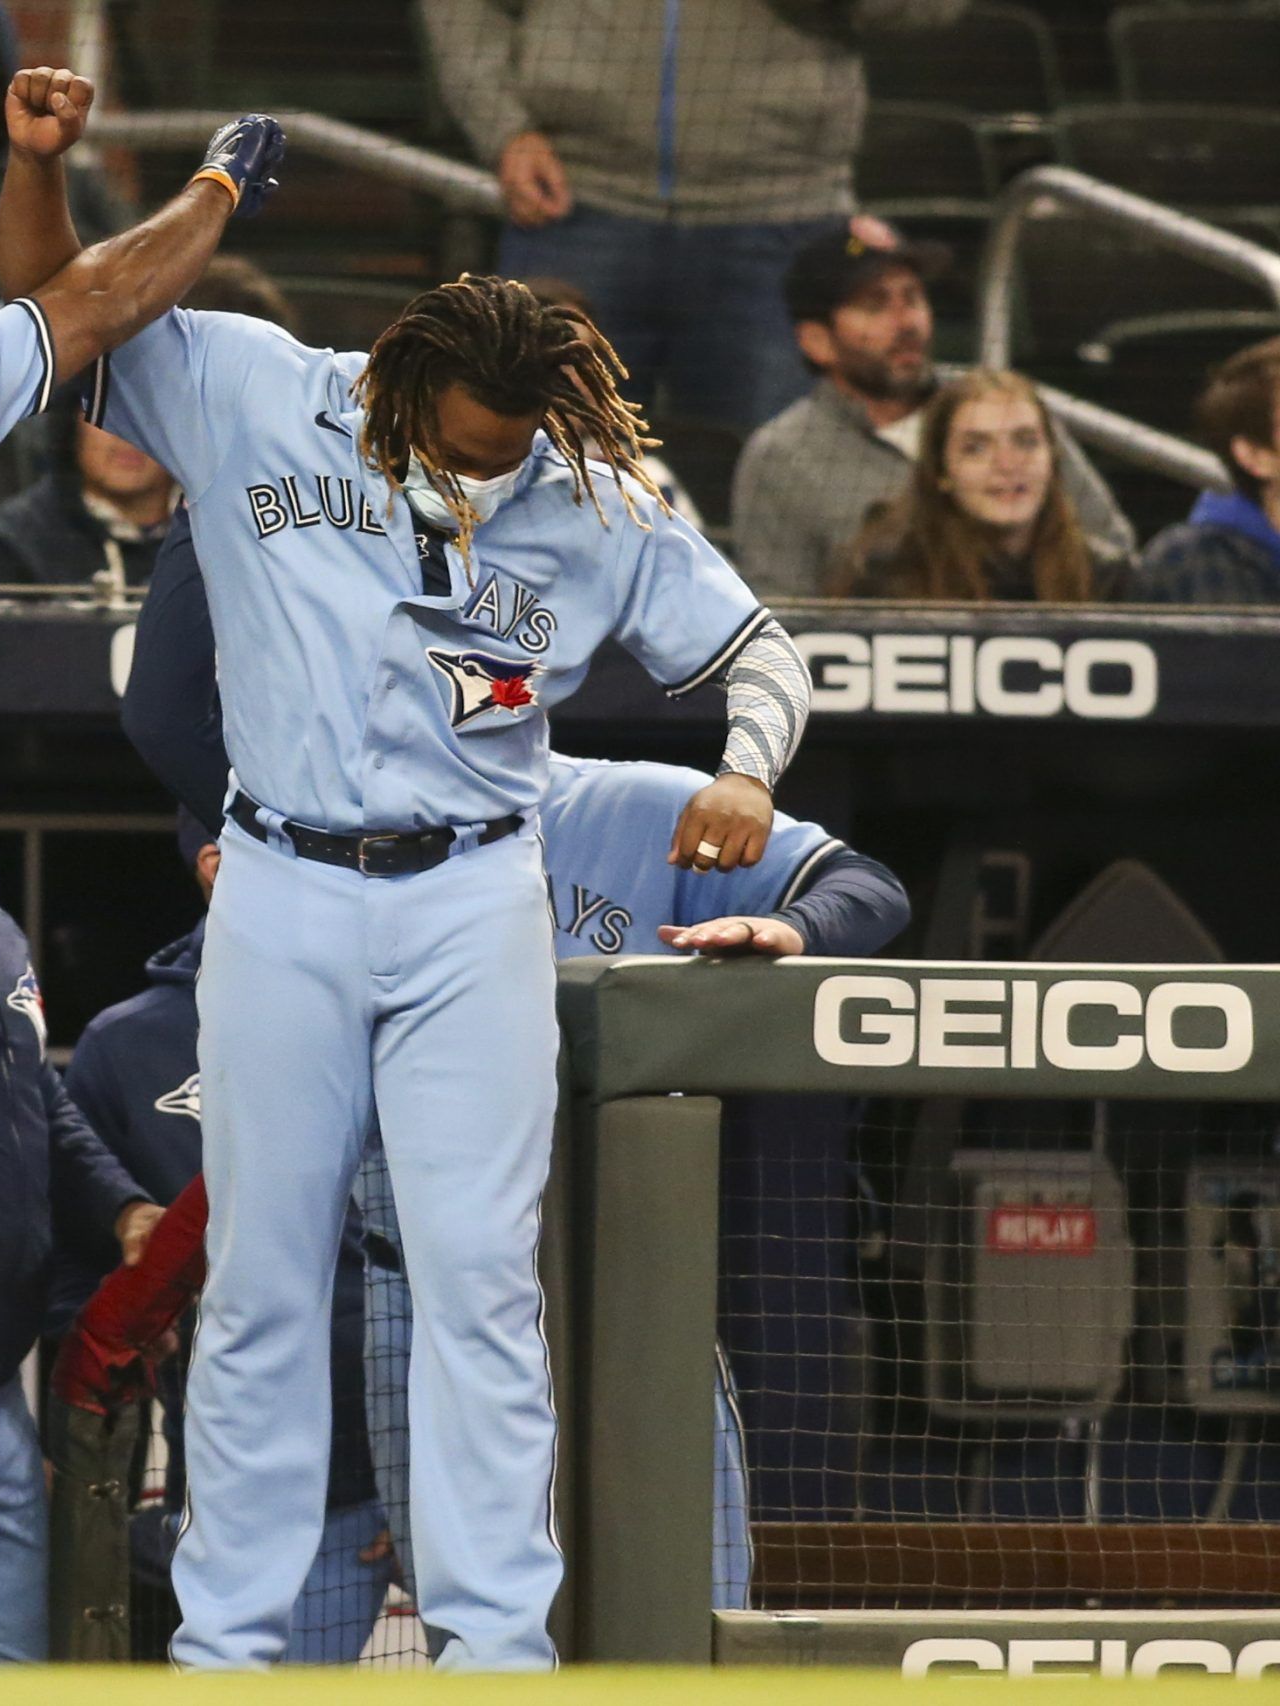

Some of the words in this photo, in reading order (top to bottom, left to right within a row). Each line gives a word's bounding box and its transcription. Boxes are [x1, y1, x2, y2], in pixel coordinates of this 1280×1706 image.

[460, 571, 558, 654] AYS
[792, 632, 1158, 719] GEICO
[814, 975, 1253, 1072] GEICO
